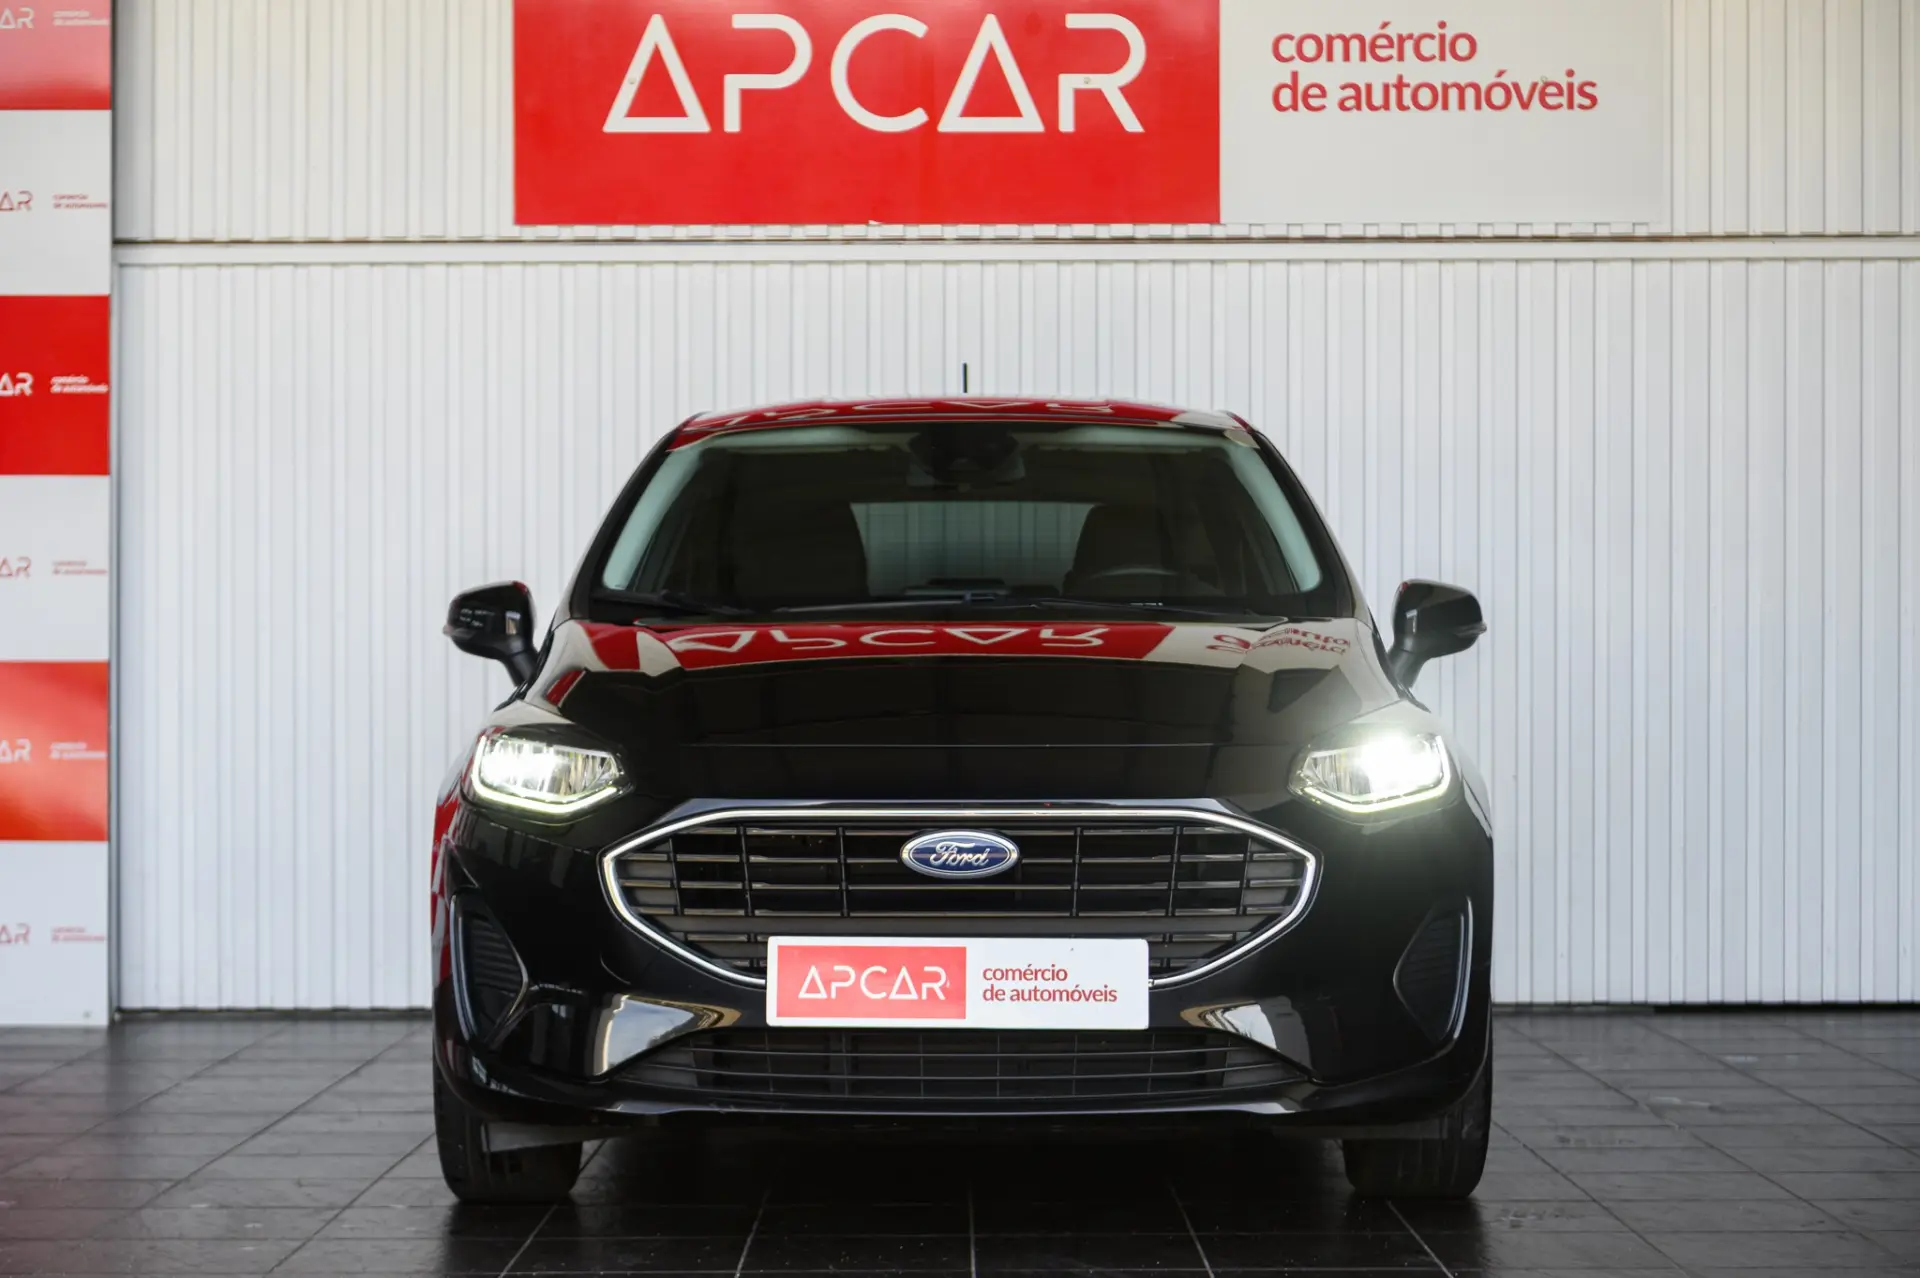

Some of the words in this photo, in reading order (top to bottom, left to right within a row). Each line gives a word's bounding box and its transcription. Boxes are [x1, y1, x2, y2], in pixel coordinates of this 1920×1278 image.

[1271, 20, 1478, 63] comércio
[602, 13, 1147, 133] APCAR
[1271, 70, 1328, 113] de
[1336, 68, 1599, 113] automóveis
[929, 841, 990, 866] Ford
[798, 965, 946, 1000] APCAR
[982, 963, 1069, 982] comércio
[982, 984, 1006, 1002] de
[1010, 984, 1118, 1003] automóveis
